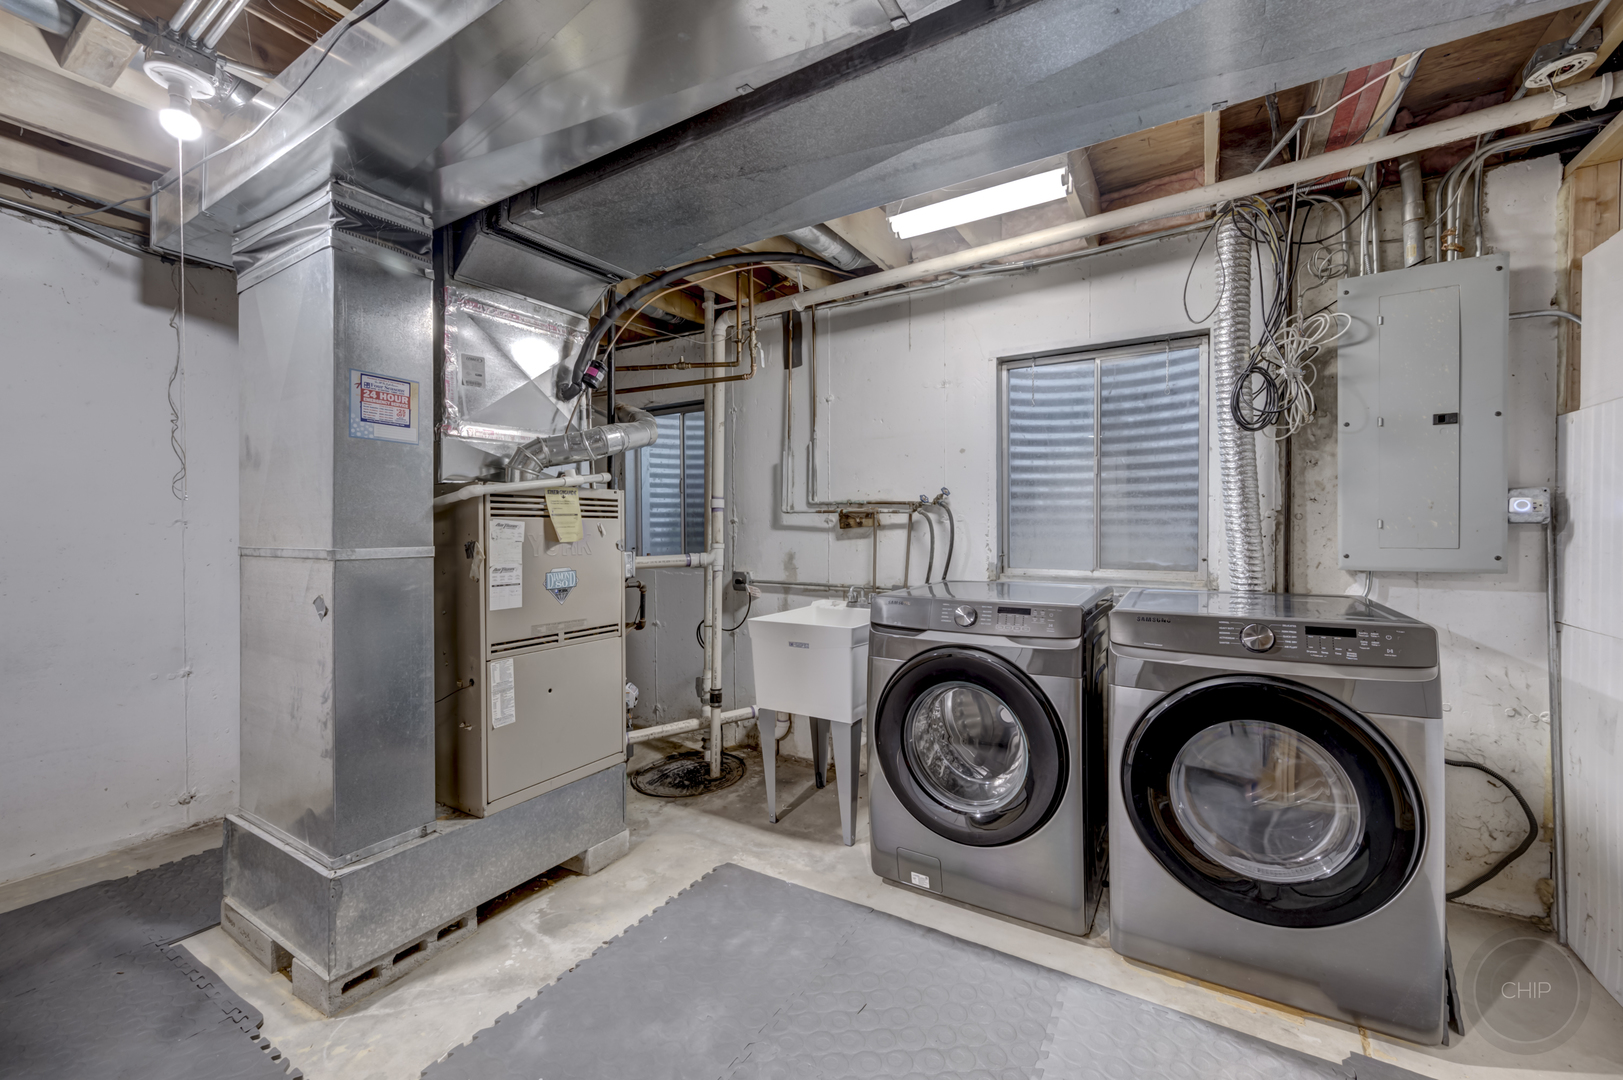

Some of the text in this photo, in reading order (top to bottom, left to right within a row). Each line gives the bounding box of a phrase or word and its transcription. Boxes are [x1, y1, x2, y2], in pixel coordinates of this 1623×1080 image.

[363, 390, 377, 399] 24
[379, 392, 409, 404] HOUR
[363, 397, 390, 405] EMERGENCY
[547, 570, 576, 589] DIAMOND
[555, 580, 568, 588] 80
